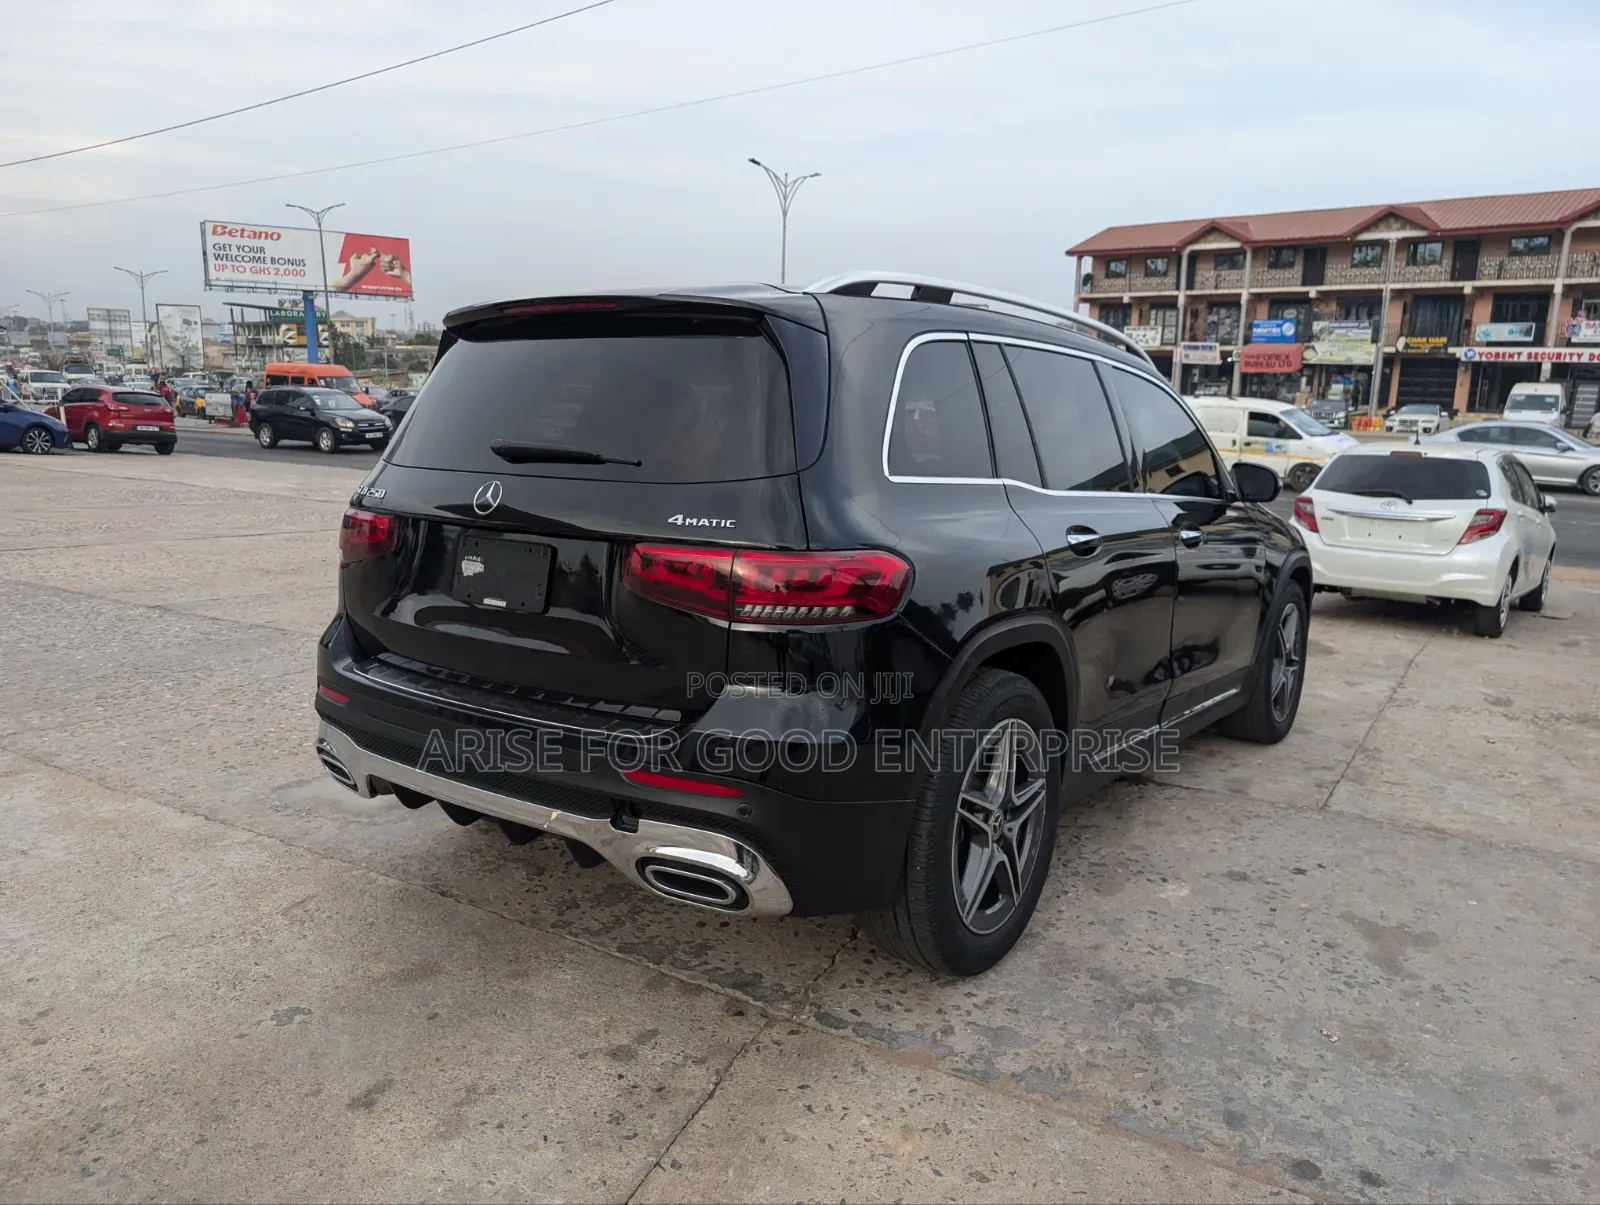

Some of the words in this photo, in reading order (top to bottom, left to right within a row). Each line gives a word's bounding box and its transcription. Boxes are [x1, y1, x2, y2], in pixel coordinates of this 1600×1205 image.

[211, 224, 282, 241] Betano
[212, 242, 232, 252] GET
[235, 244, 266, 255] YOUR
[213, 252, 267, 265] WELCOME
[270, 256, 306, 268] BONUS
[213, 263, 228, 272] UP
[230, 264, 247, 274] TO
[249, 265, 271, 276] GHS
[270, 309, 327, 319] LABORARY
[1256, 353, 1290, 361] FOREX
[1477, 351, 1522, 360] YOBENT
[1527, 351, 1584, 361] SECURITY
[1244, 360, 1276, 369] BUREAU
[1278, 360, 1292, 368] LTD
[667, 513, 737, 528] 4MATIC
